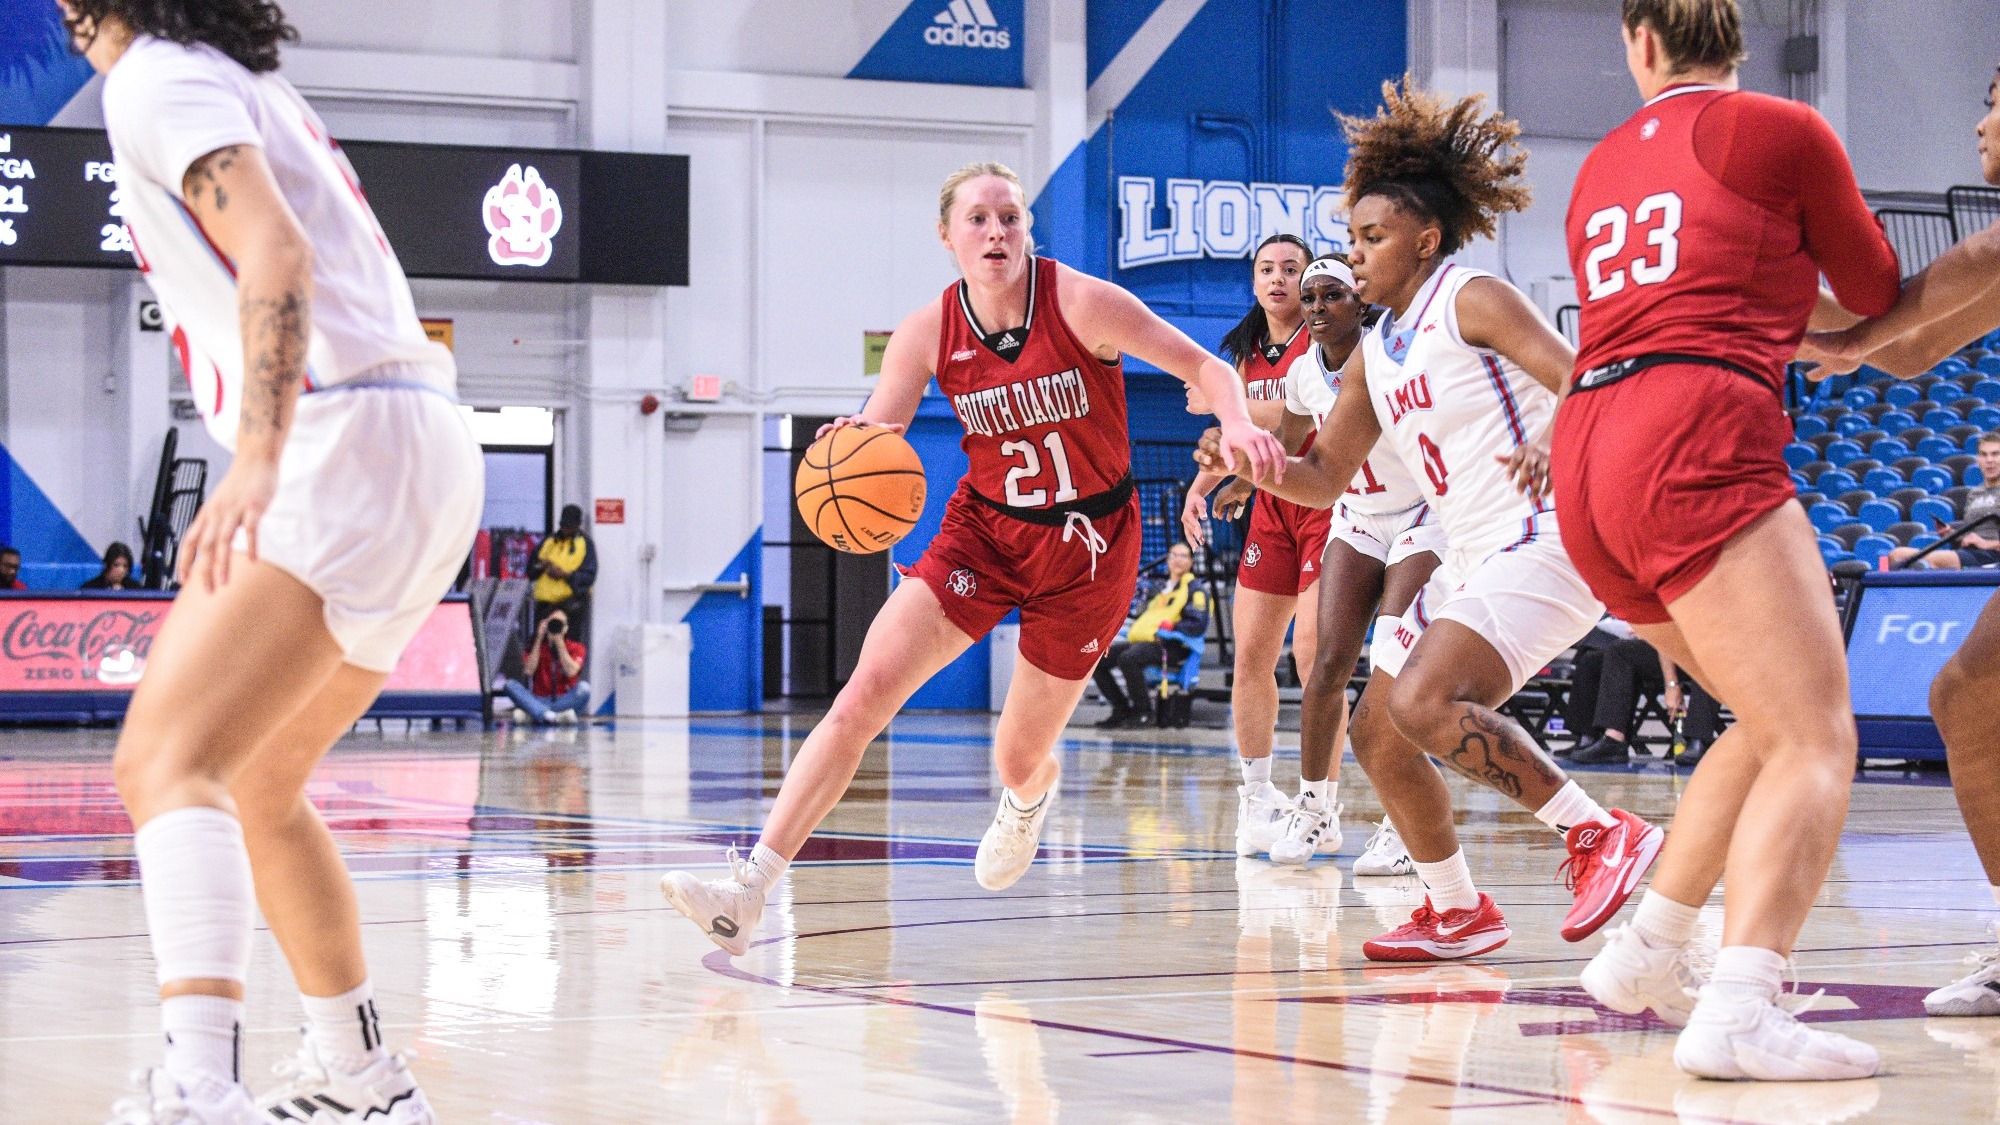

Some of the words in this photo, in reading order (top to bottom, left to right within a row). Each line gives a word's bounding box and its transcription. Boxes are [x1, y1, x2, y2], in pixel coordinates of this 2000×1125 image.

[924, 23, 1011, 50] adidas
[1584, 190, 1683, 302] 23
[996, 340, 1020, 352] adidas
[954, 384, 1020, 438] SOUTH
[1011, 366, 1090, 427] DAKOTA
[1385, 371, 1435, 428] LMU
[1000, 431, 1079, 508] 21
[1418, 433, 1449, 497] 0
[1877, 614, 1960, 645] For
[25, 667, 74, 681] ZERO
